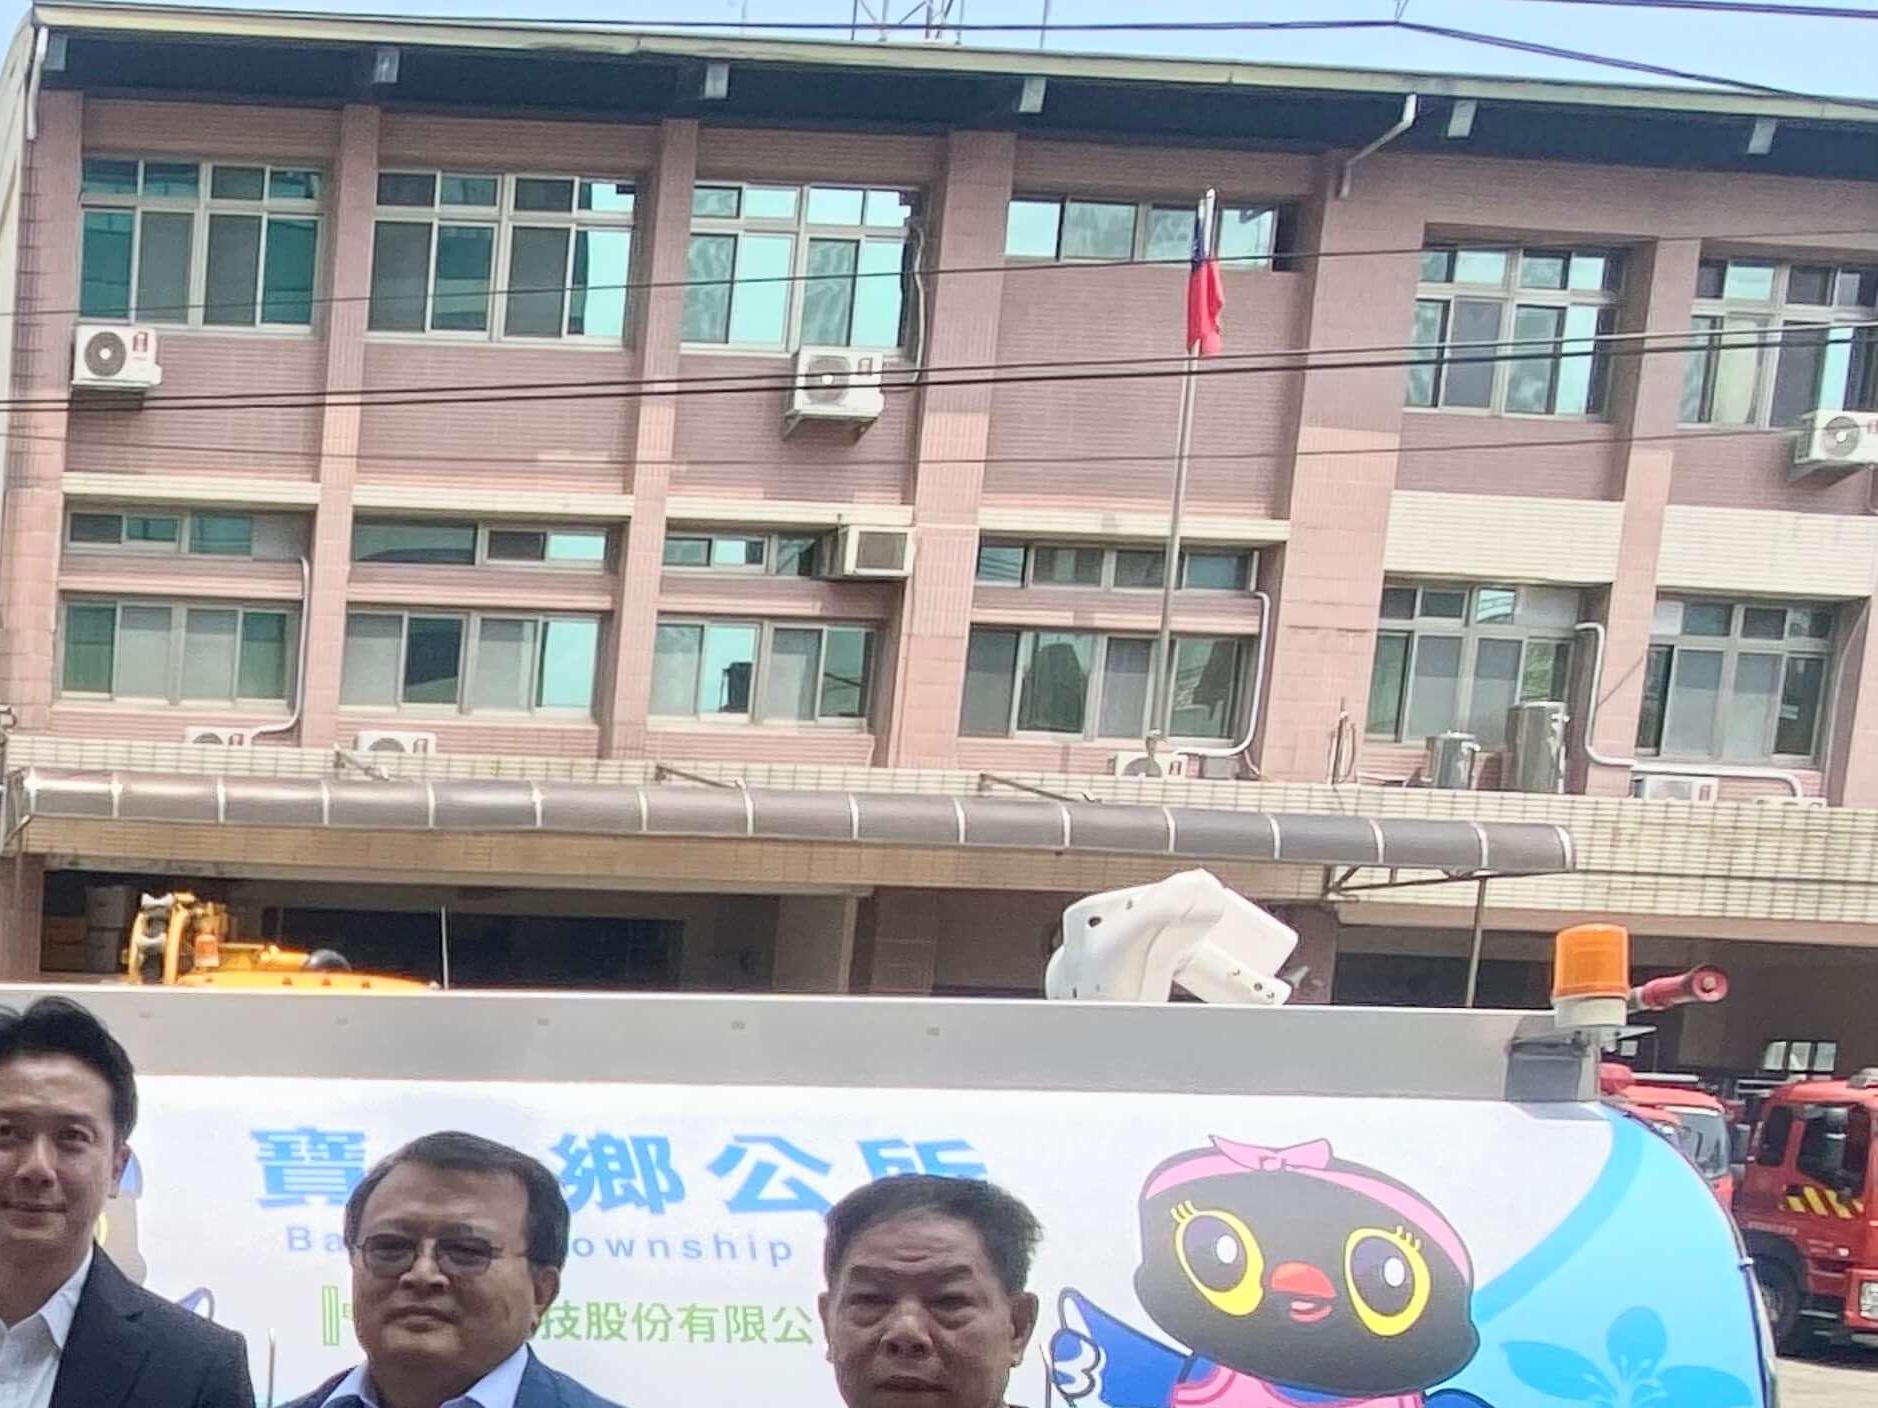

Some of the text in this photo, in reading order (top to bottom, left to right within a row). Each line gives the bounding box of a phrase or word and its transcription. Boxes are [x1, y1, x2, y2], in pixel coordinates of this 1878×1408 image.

[249, 1126, 990, 1216] 寶鄉公所
[573, 1232, 794, 1267] ownship
[540, 1300, 815, 1345] 技股份有限公
